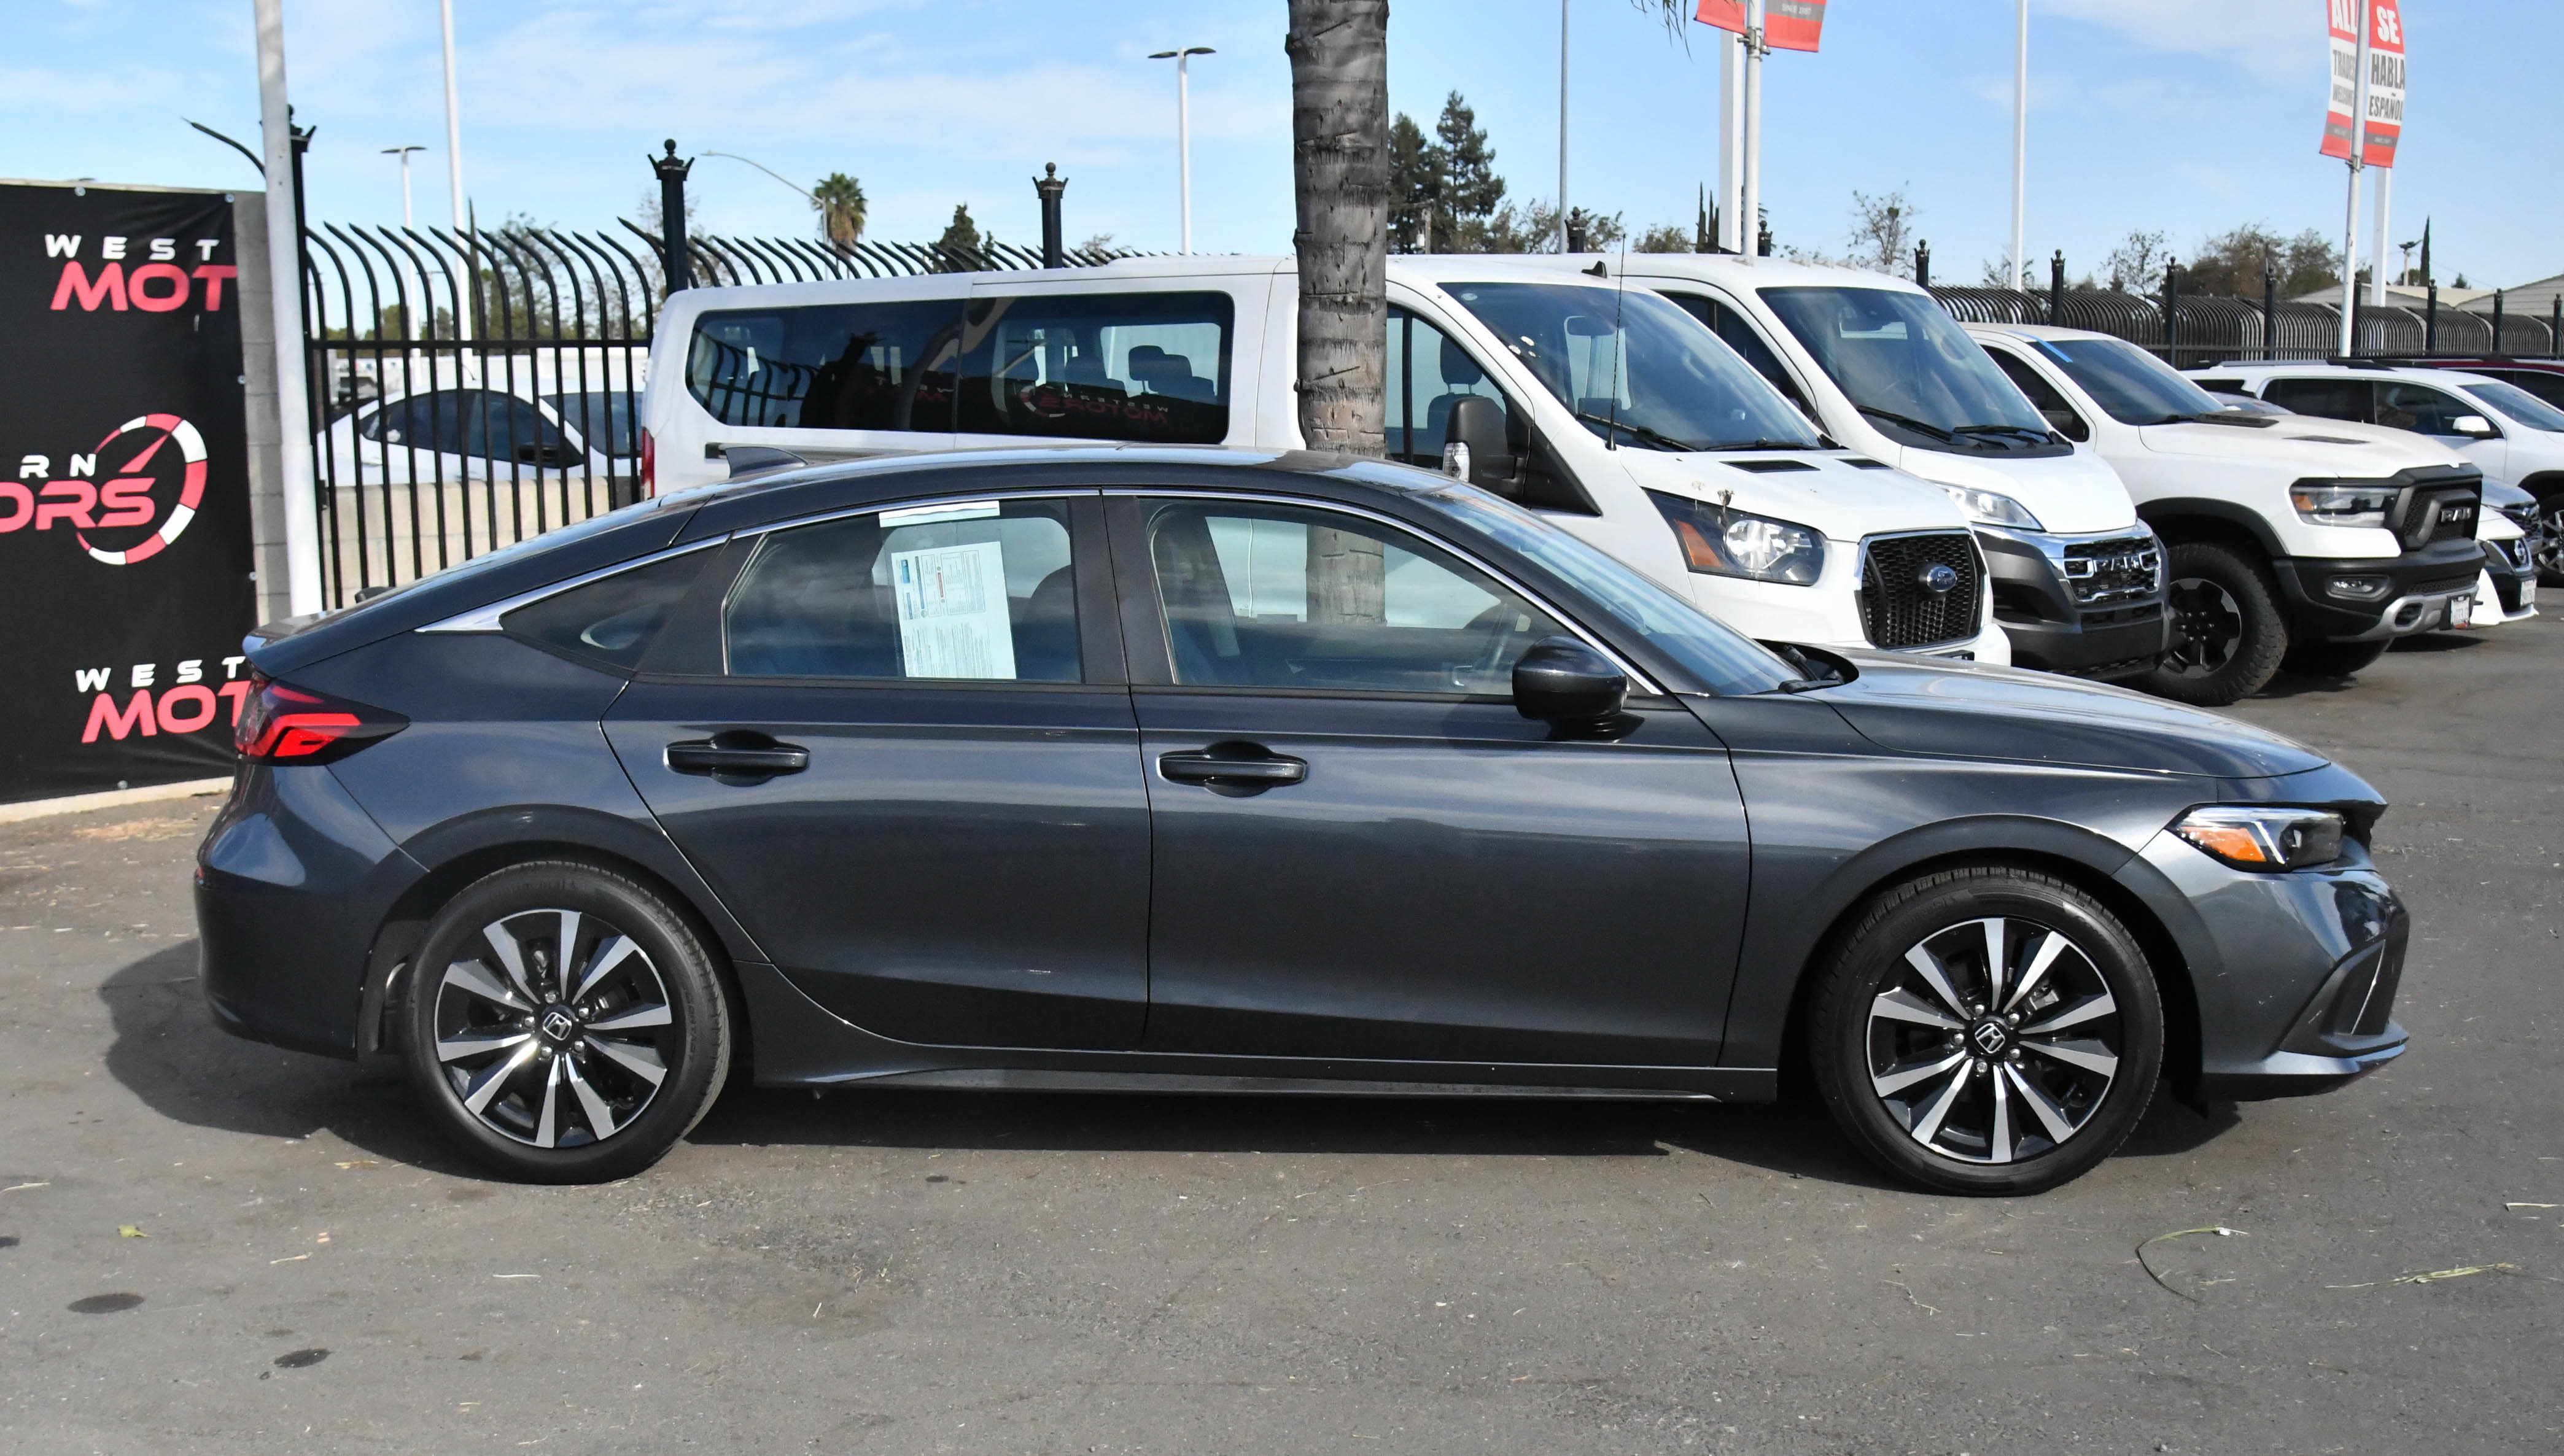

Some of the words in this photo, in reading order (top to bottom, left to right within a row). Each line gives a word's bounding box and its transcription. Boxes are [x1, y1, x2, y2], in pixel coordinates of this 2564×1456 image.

[2376, 5, 2400, 44] SE
[2371, 53, 2405, 90] HABLA
[2368, 93, 2403, 121] ESPAÑOL
[45, 234, 219, 261] WEST
[50, 261, 238, 312] MOT
[20, 453, 96, 479] RN
[76, 656, 246, 693] WEST
